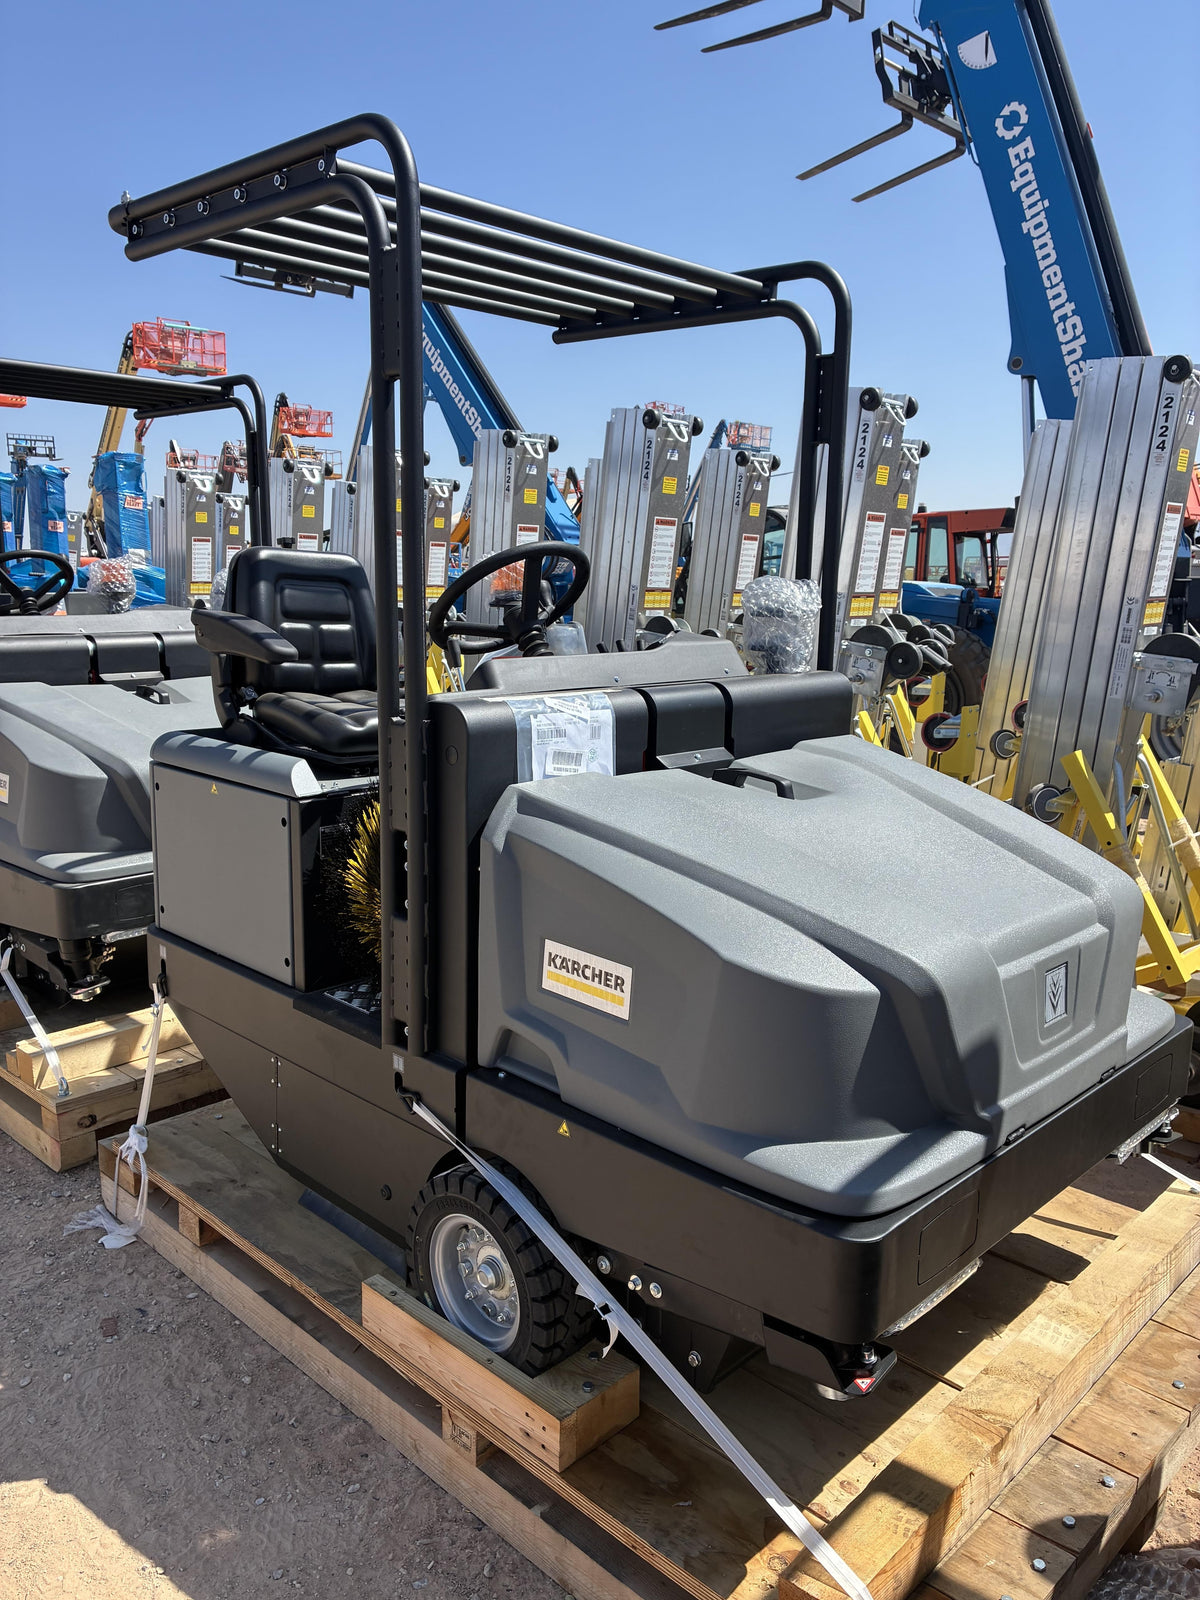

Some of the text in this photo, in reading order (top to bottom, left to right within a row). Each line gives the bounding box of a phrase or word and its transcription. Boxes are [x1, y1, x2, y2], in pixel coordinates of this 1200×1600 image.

[1156, 396, 1175, 452] 2124
[643, 439, 653, 480] 2124
[856, 422, 870, 470] 2124
[505, 456, 513, 492] 2124
[734, 475, 744, 507] 2124
[548, 951, 626, 994] KÄRCHER
